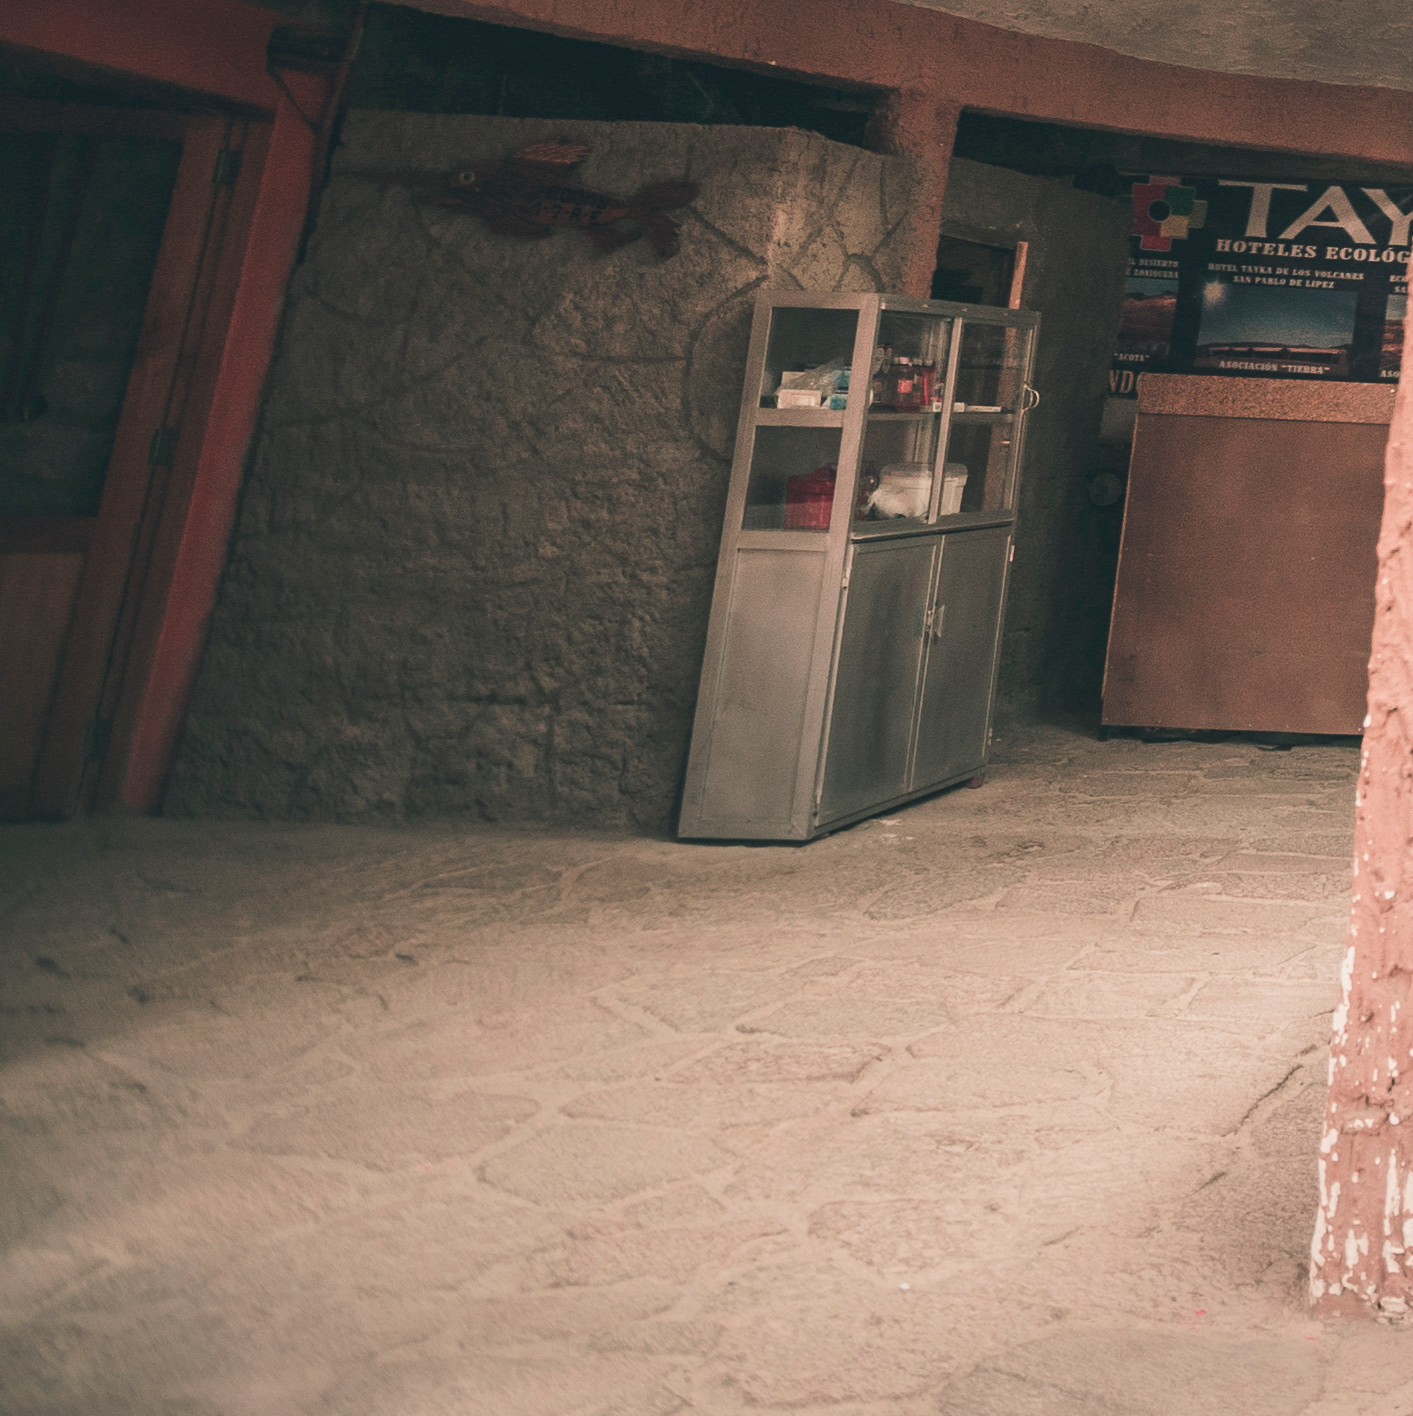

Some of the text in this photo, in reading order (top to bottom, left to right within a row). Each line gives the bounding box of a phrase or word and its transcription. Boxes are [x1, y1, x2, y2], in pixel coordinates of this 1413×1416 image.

[1215, 238, 1412, 265] HOTELES ECOLÓG
[1275, 266, 1289, 276] DE
[1292, 268, 1311, 277] LOS
[1233, 275, 1252, 284] SAN
[1254, 276, 1286, 286] PABLO
[1289, 278, 1302, 288] DE
